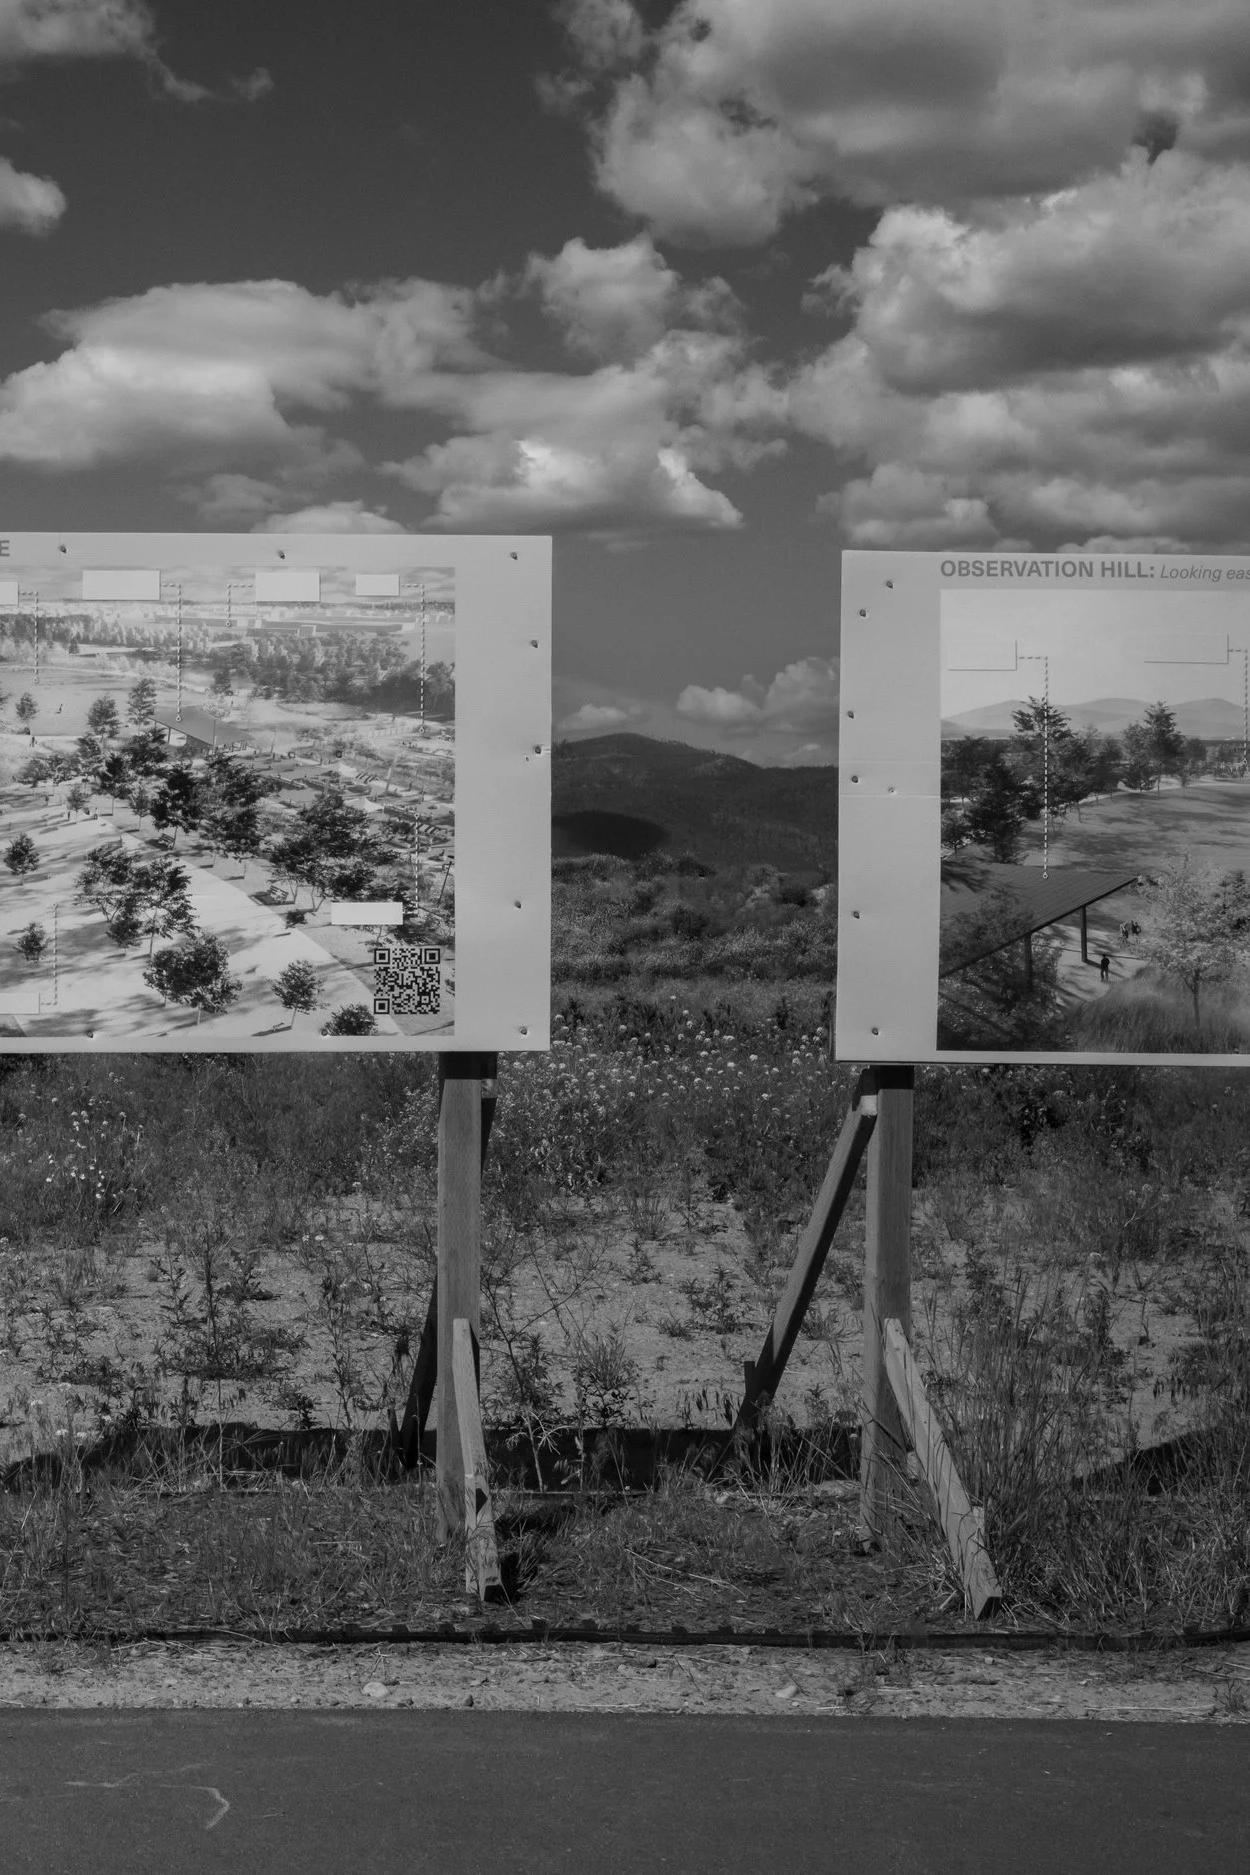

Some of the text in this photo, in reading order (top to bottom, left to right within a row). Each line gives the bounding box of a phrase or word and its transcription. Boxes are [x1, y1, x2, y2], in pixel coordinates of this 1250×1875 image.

[940, 559, 1094, 578] OBSERVATION
[1100, 560, 1155, 579] HILL:
[1160, 565, 1223, 583] Looking
